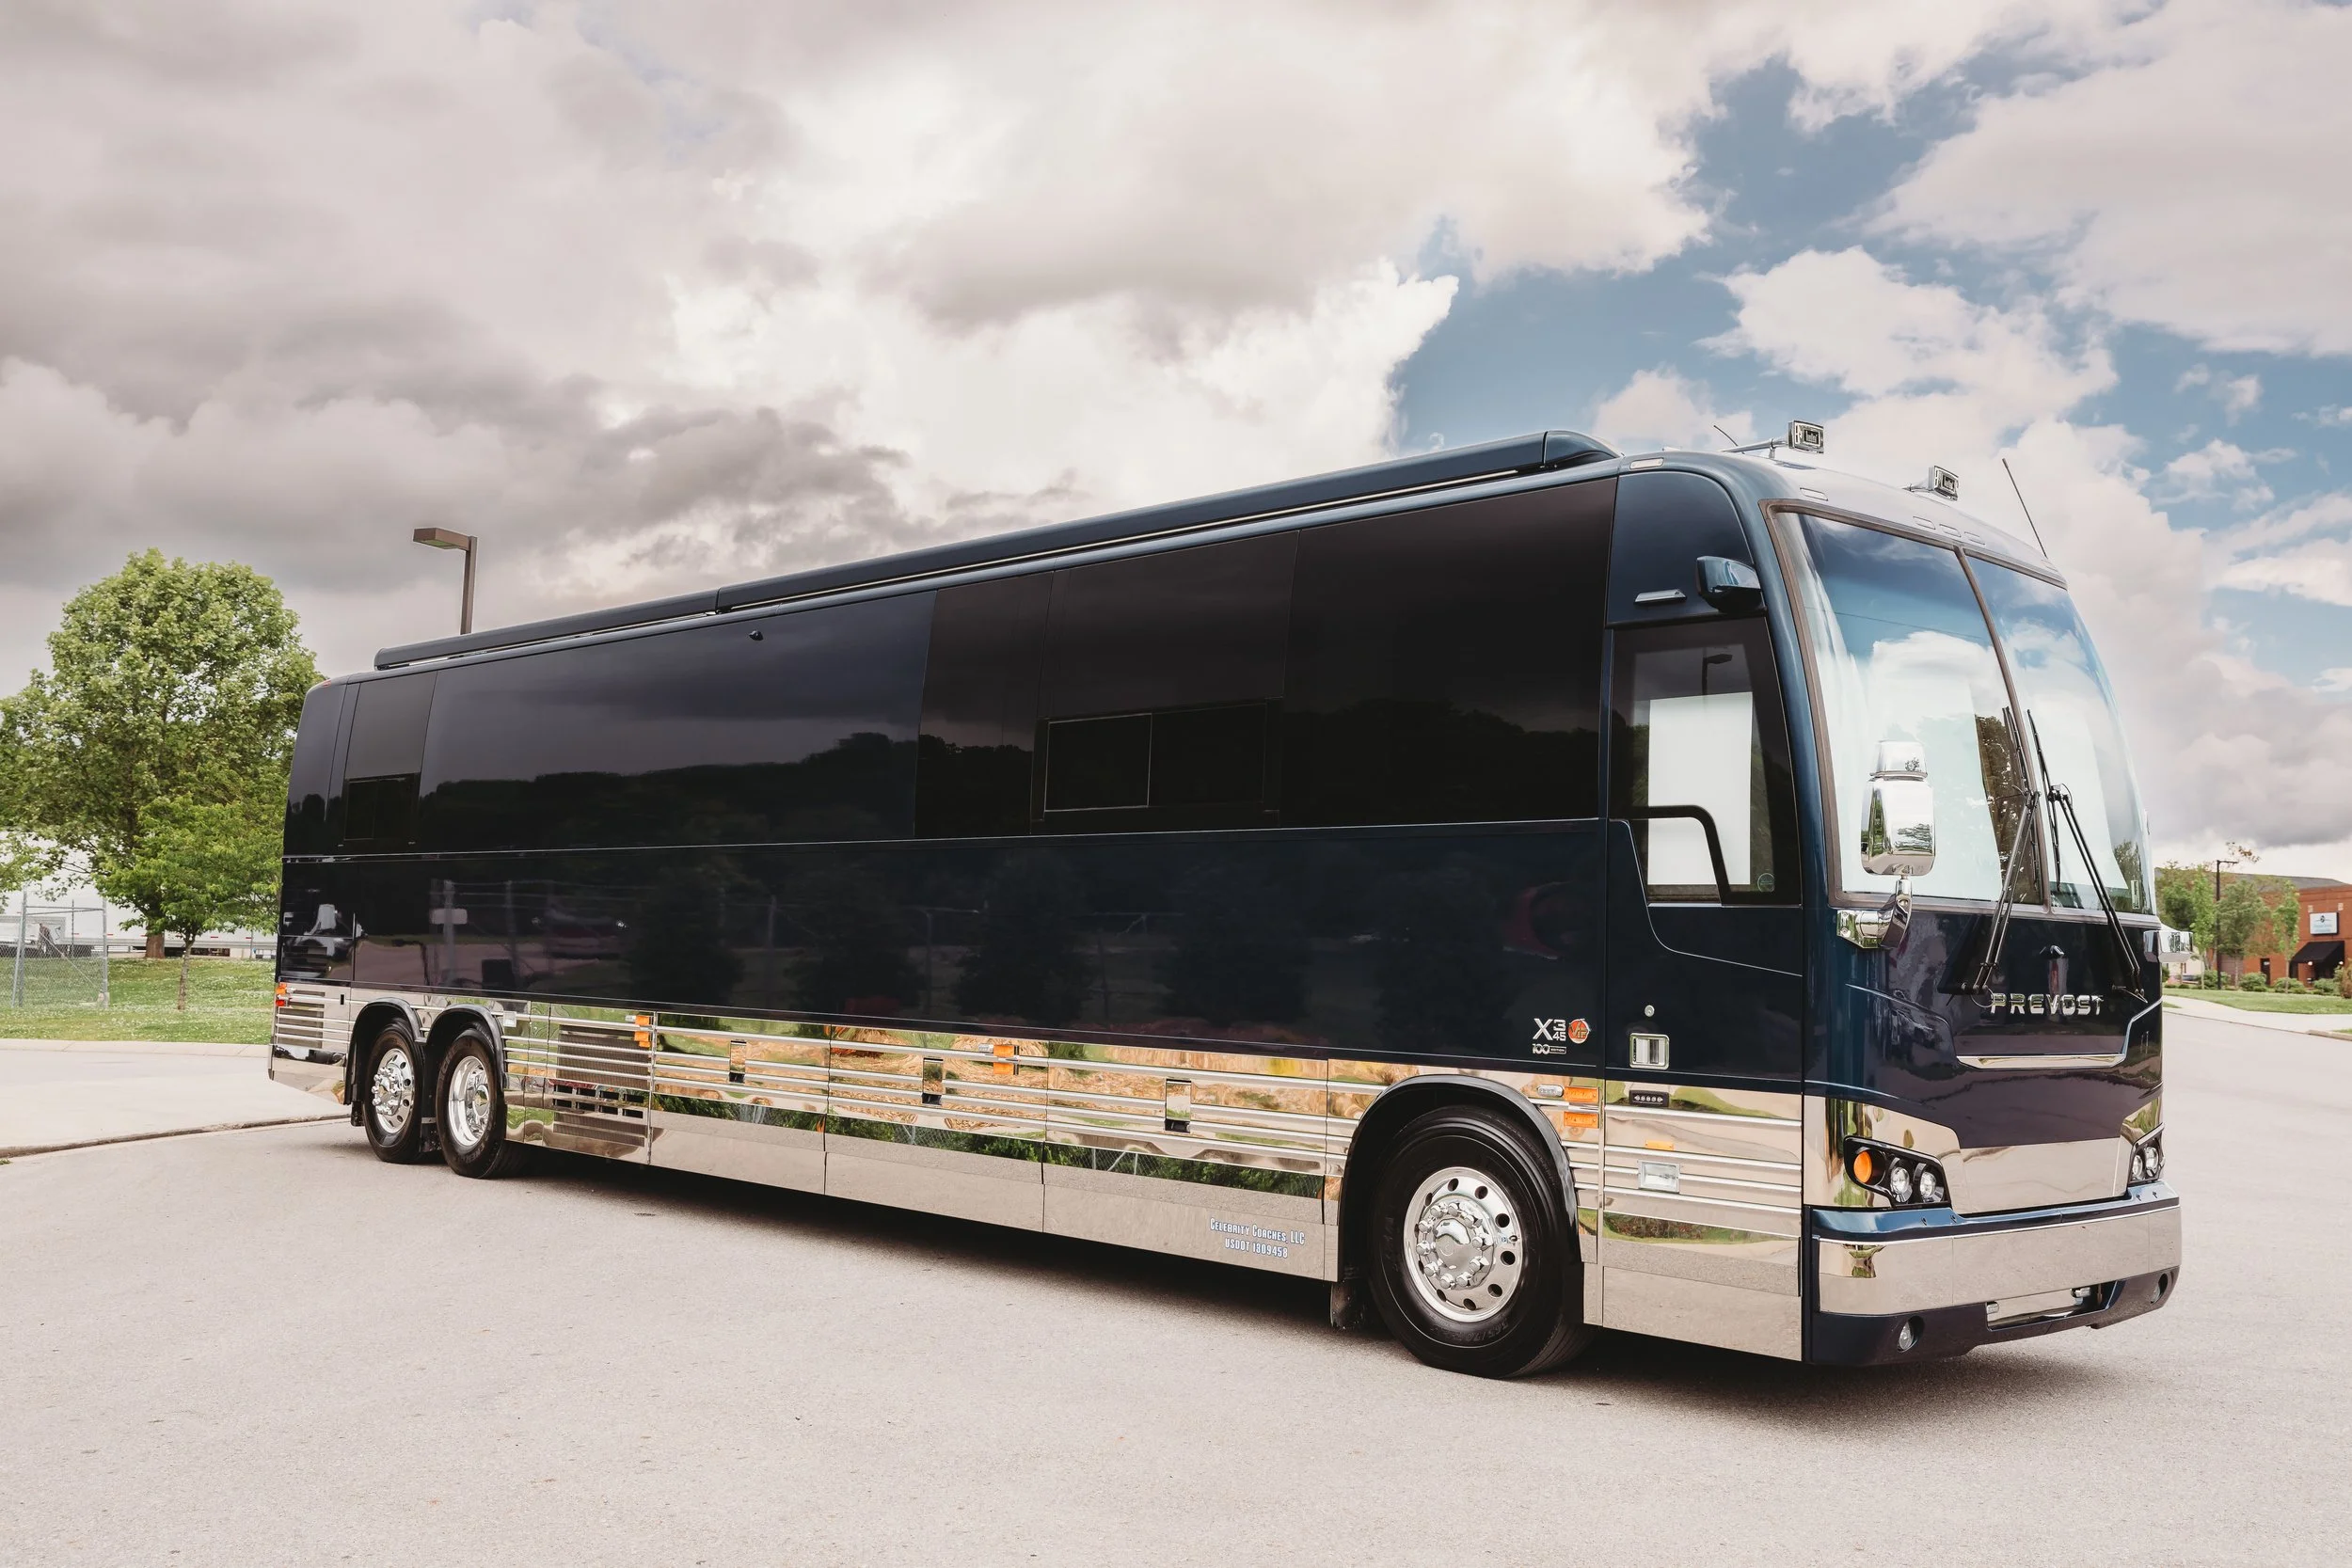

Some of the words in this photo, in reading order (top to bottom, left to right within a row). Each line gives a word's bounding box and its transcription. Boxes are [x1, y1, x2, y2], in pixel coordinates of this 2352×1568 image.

[1990, 992, 2104, 1016] PREVOST
[1290, 1230, 1305, 1245] LLC
[1225, 1238, 1250, 1252] USDOT
[1252, 1243, 1288, 1259] 1309458
